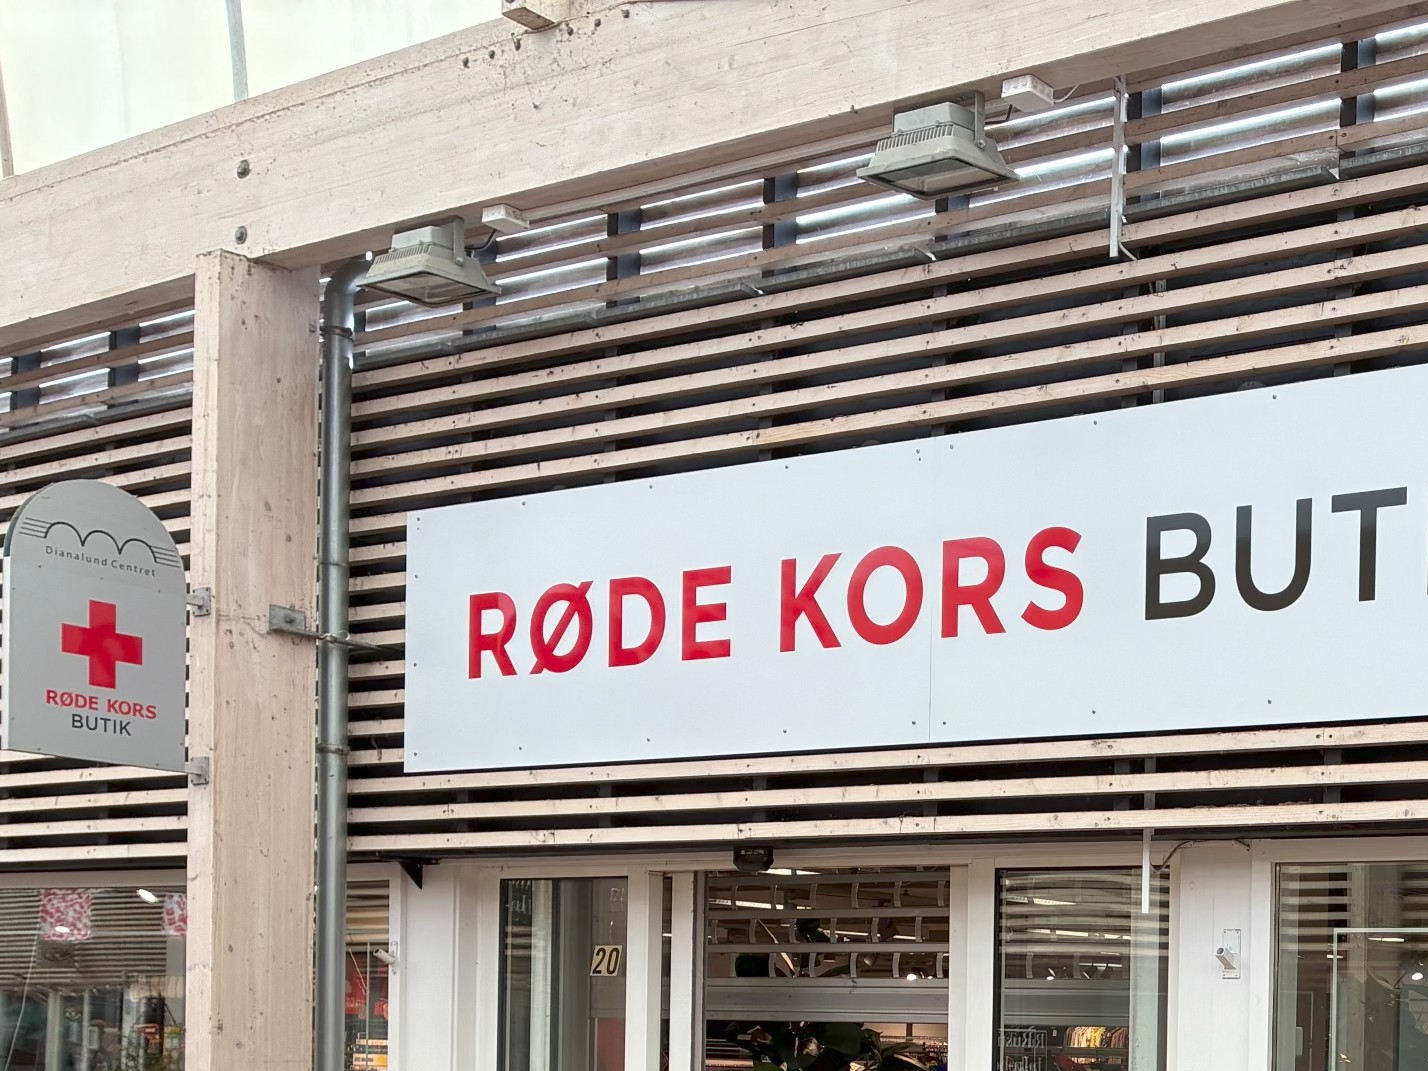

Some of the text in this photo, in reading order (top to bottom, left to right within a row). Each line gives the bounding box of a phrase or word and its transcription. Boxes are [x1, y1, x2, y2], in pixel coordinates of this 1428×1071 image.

[45, 545, 156, 577] Dianalund Centret
[467, 564, 733, 681] RØDE
[778, 525, 1086, 655] KORS
[46, 689, 158, 720] RØDE KORS
[71, 713, 132, 736] BUTIK
[592, 947, 620, 975] 20
